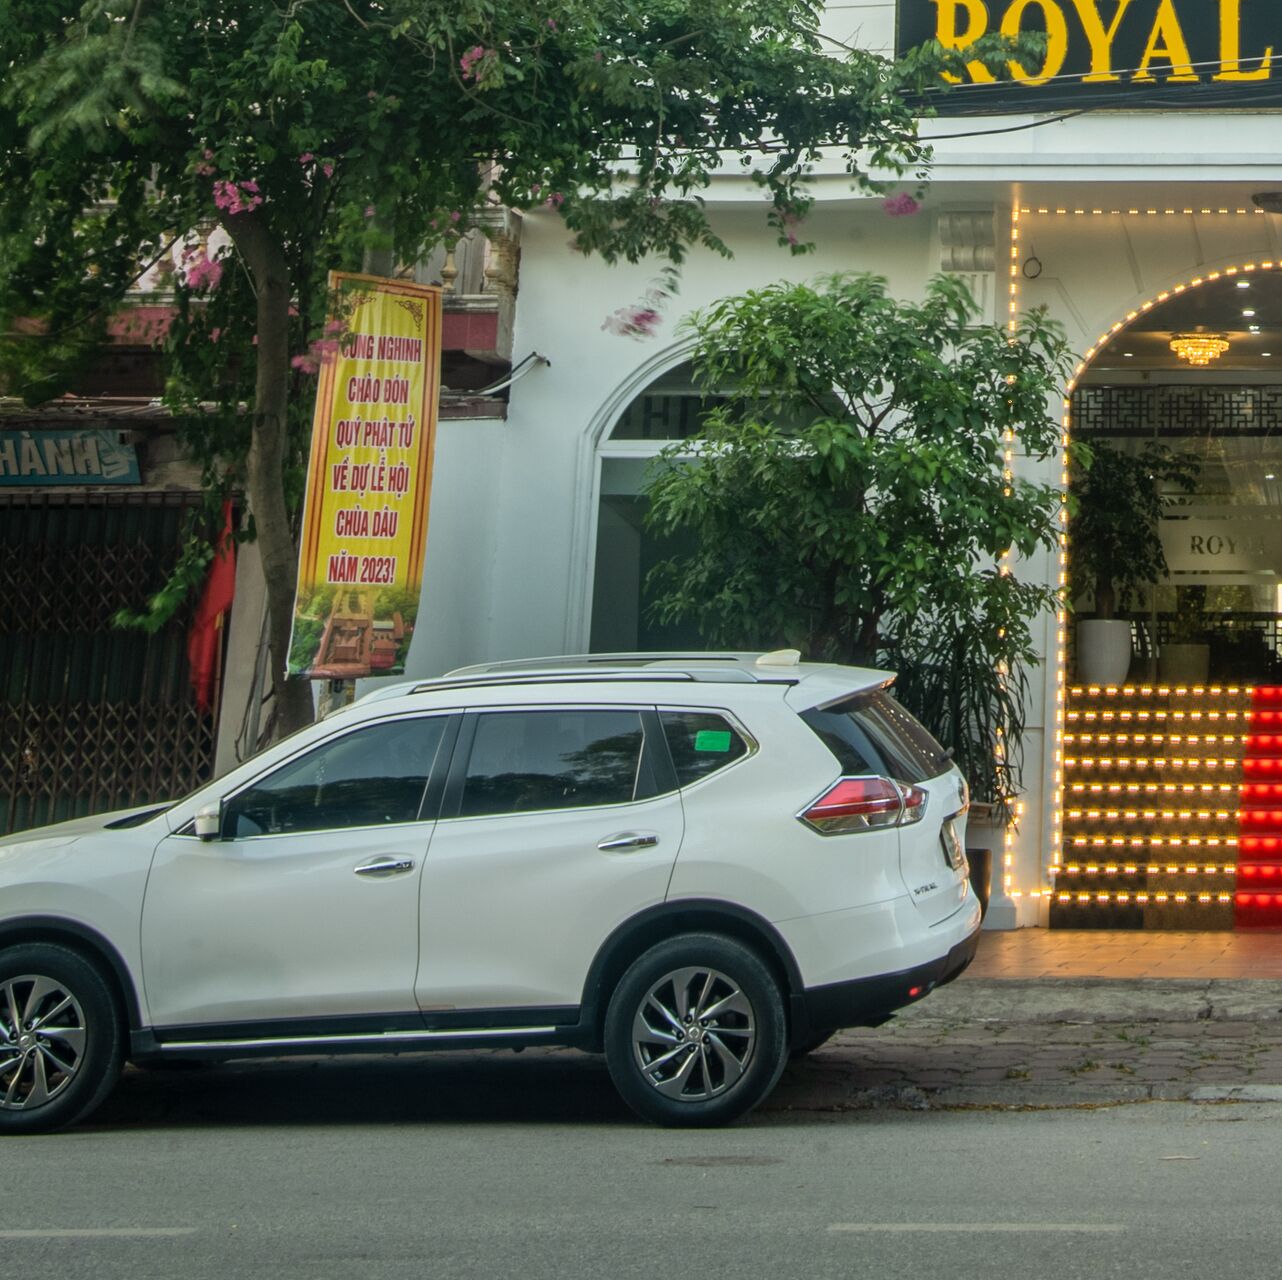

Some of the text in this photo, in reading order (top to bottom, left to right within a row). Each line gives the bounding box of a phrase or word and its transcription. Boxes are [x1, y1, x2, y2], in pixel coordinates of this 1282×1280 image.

[377, 335, 422, 362] NGHINH
[348, 372, 409, 404] CHÀO ĐÓN
[336, 414, 415, 452] QUÝ PHẬT TỬ
[333, 456, 410, 498] VỀ DỰ LỄ HỘI
[335, 504, 398, 538] CHÙA DÂU
[1189, 533, 1270, 556] ROY
[328, 549, 396, 583] NĂM 2023!
